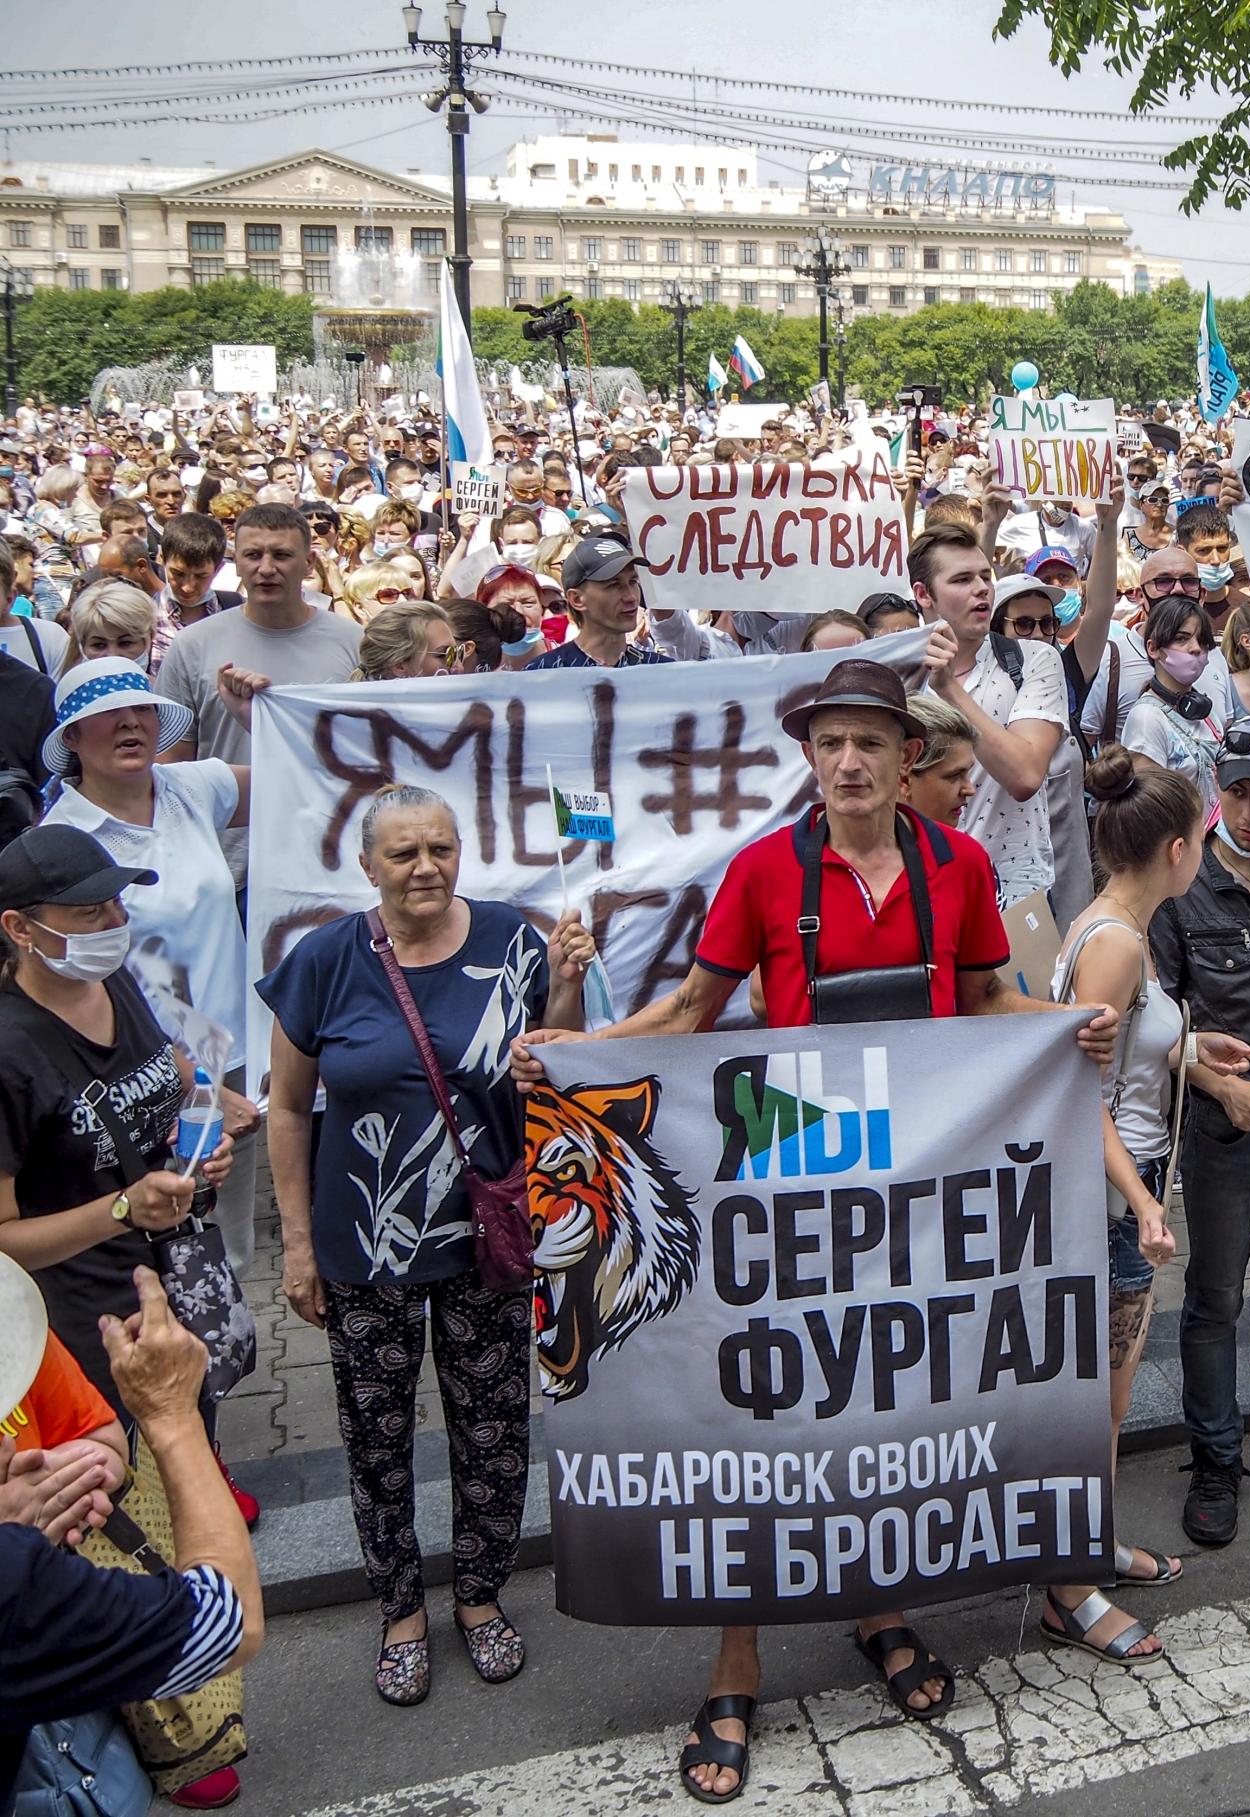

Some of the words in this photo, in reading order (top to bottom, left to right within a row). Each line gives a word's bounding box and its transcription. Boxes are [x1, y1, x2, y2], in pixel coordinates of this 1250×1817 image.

[456, 480, 499, 499] СЕРГЕЙ
[995, 438, 1113, 500] ЦВЕТКОВА
[456, 496, 498, 516] ФУРГАЛ
[639, 507, 903, 580] СЛЕДСТВИЯ
[574, 794, 599, 812] ВЫБОР
[711, 1141, 1052, 1306] СЕРГЕЙ
[718, 1275, 1098, 1420] ФУРГАЛ
[556, 1449, 836, 1507] ХАБАРОВСК
[848, 1421, 999, 1497] СВОИХ
[660, 1517, 751, 1599] НЕ
[775, 1476, 1103, 1598] БРОСАЕТ!
